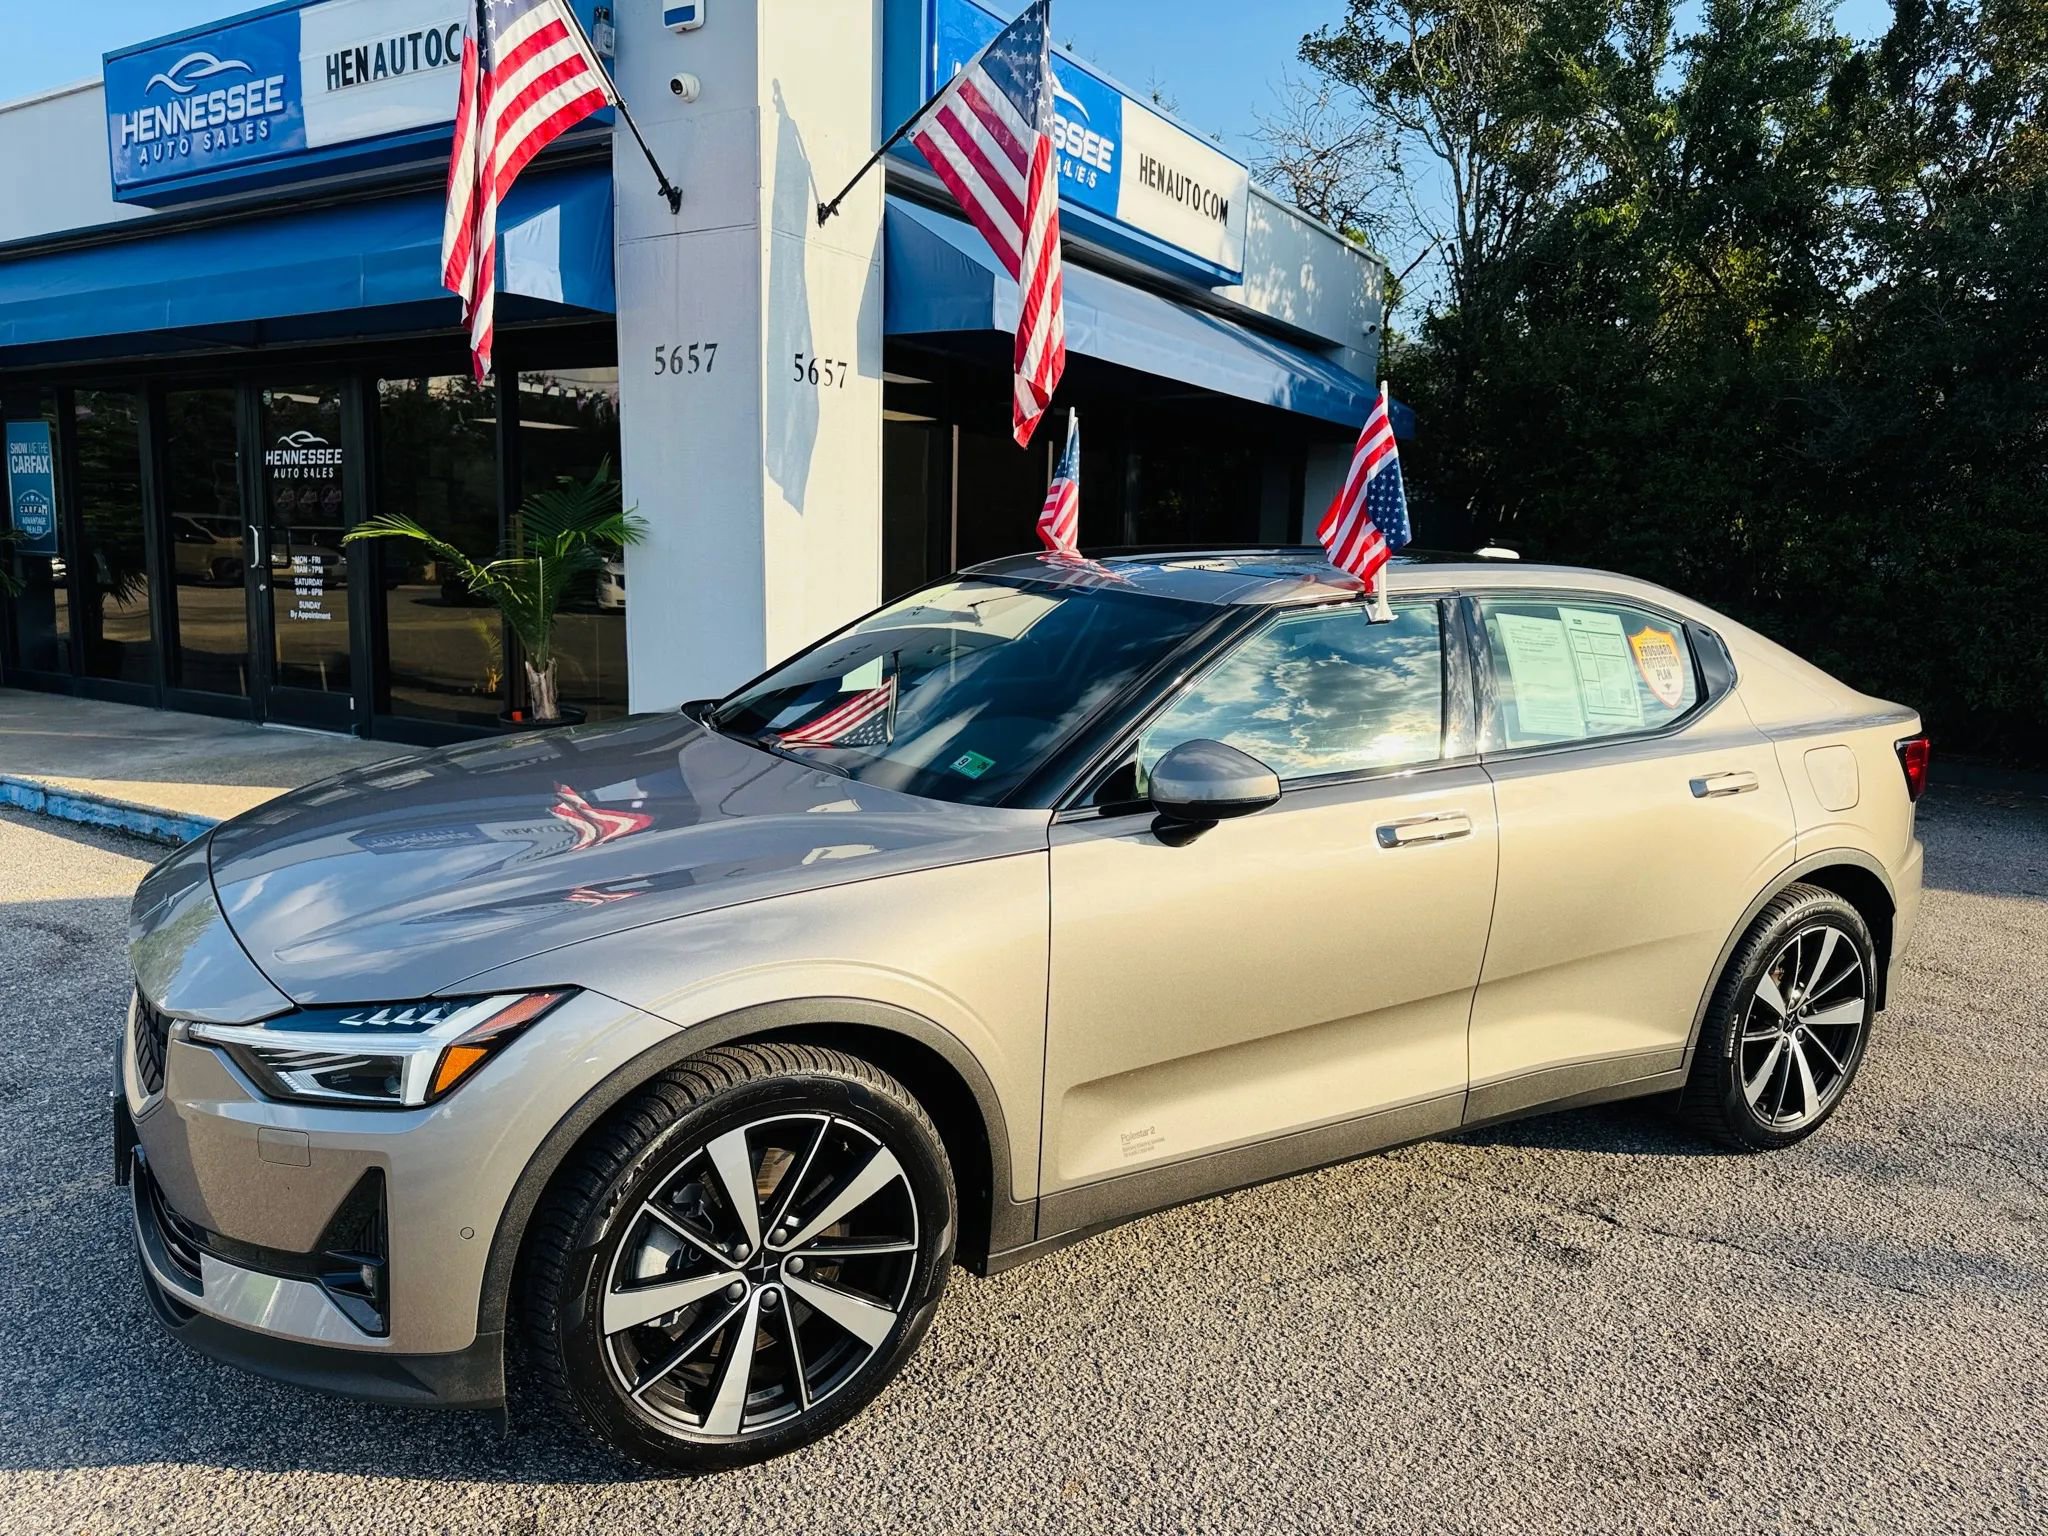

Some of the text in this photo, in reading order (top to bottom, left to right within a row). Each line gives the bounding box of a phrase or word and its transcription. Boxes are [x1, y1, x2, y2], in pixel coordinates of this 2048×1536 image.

[326, 22, 467, 90] HENAUTO.C
[121, 74, 284, 146] HENNESSEE
[139, 119, 268, 164] AUTO SALES
[654, 341, 718, 376] 5657
[793, 351, 848, 389] 5657
[10, 442, 28, 455] SHOW
[265, 448, 343, 466] HENNESSEE
[11, 454, 50, 474] CARFAX
[273, 466, 334, 479] AUTO SALES
[293, 555, 308, 565] MON
[311, 555, 322, 565] FRI
[311, 565, 324, 574] 7PM
[294, 577, 324, 586] SATURDAY
[298, 600, 322, 610] SUNDAY
[289, 609, 298, 620] By
[1655, 668, 1673, 681] PLAN
